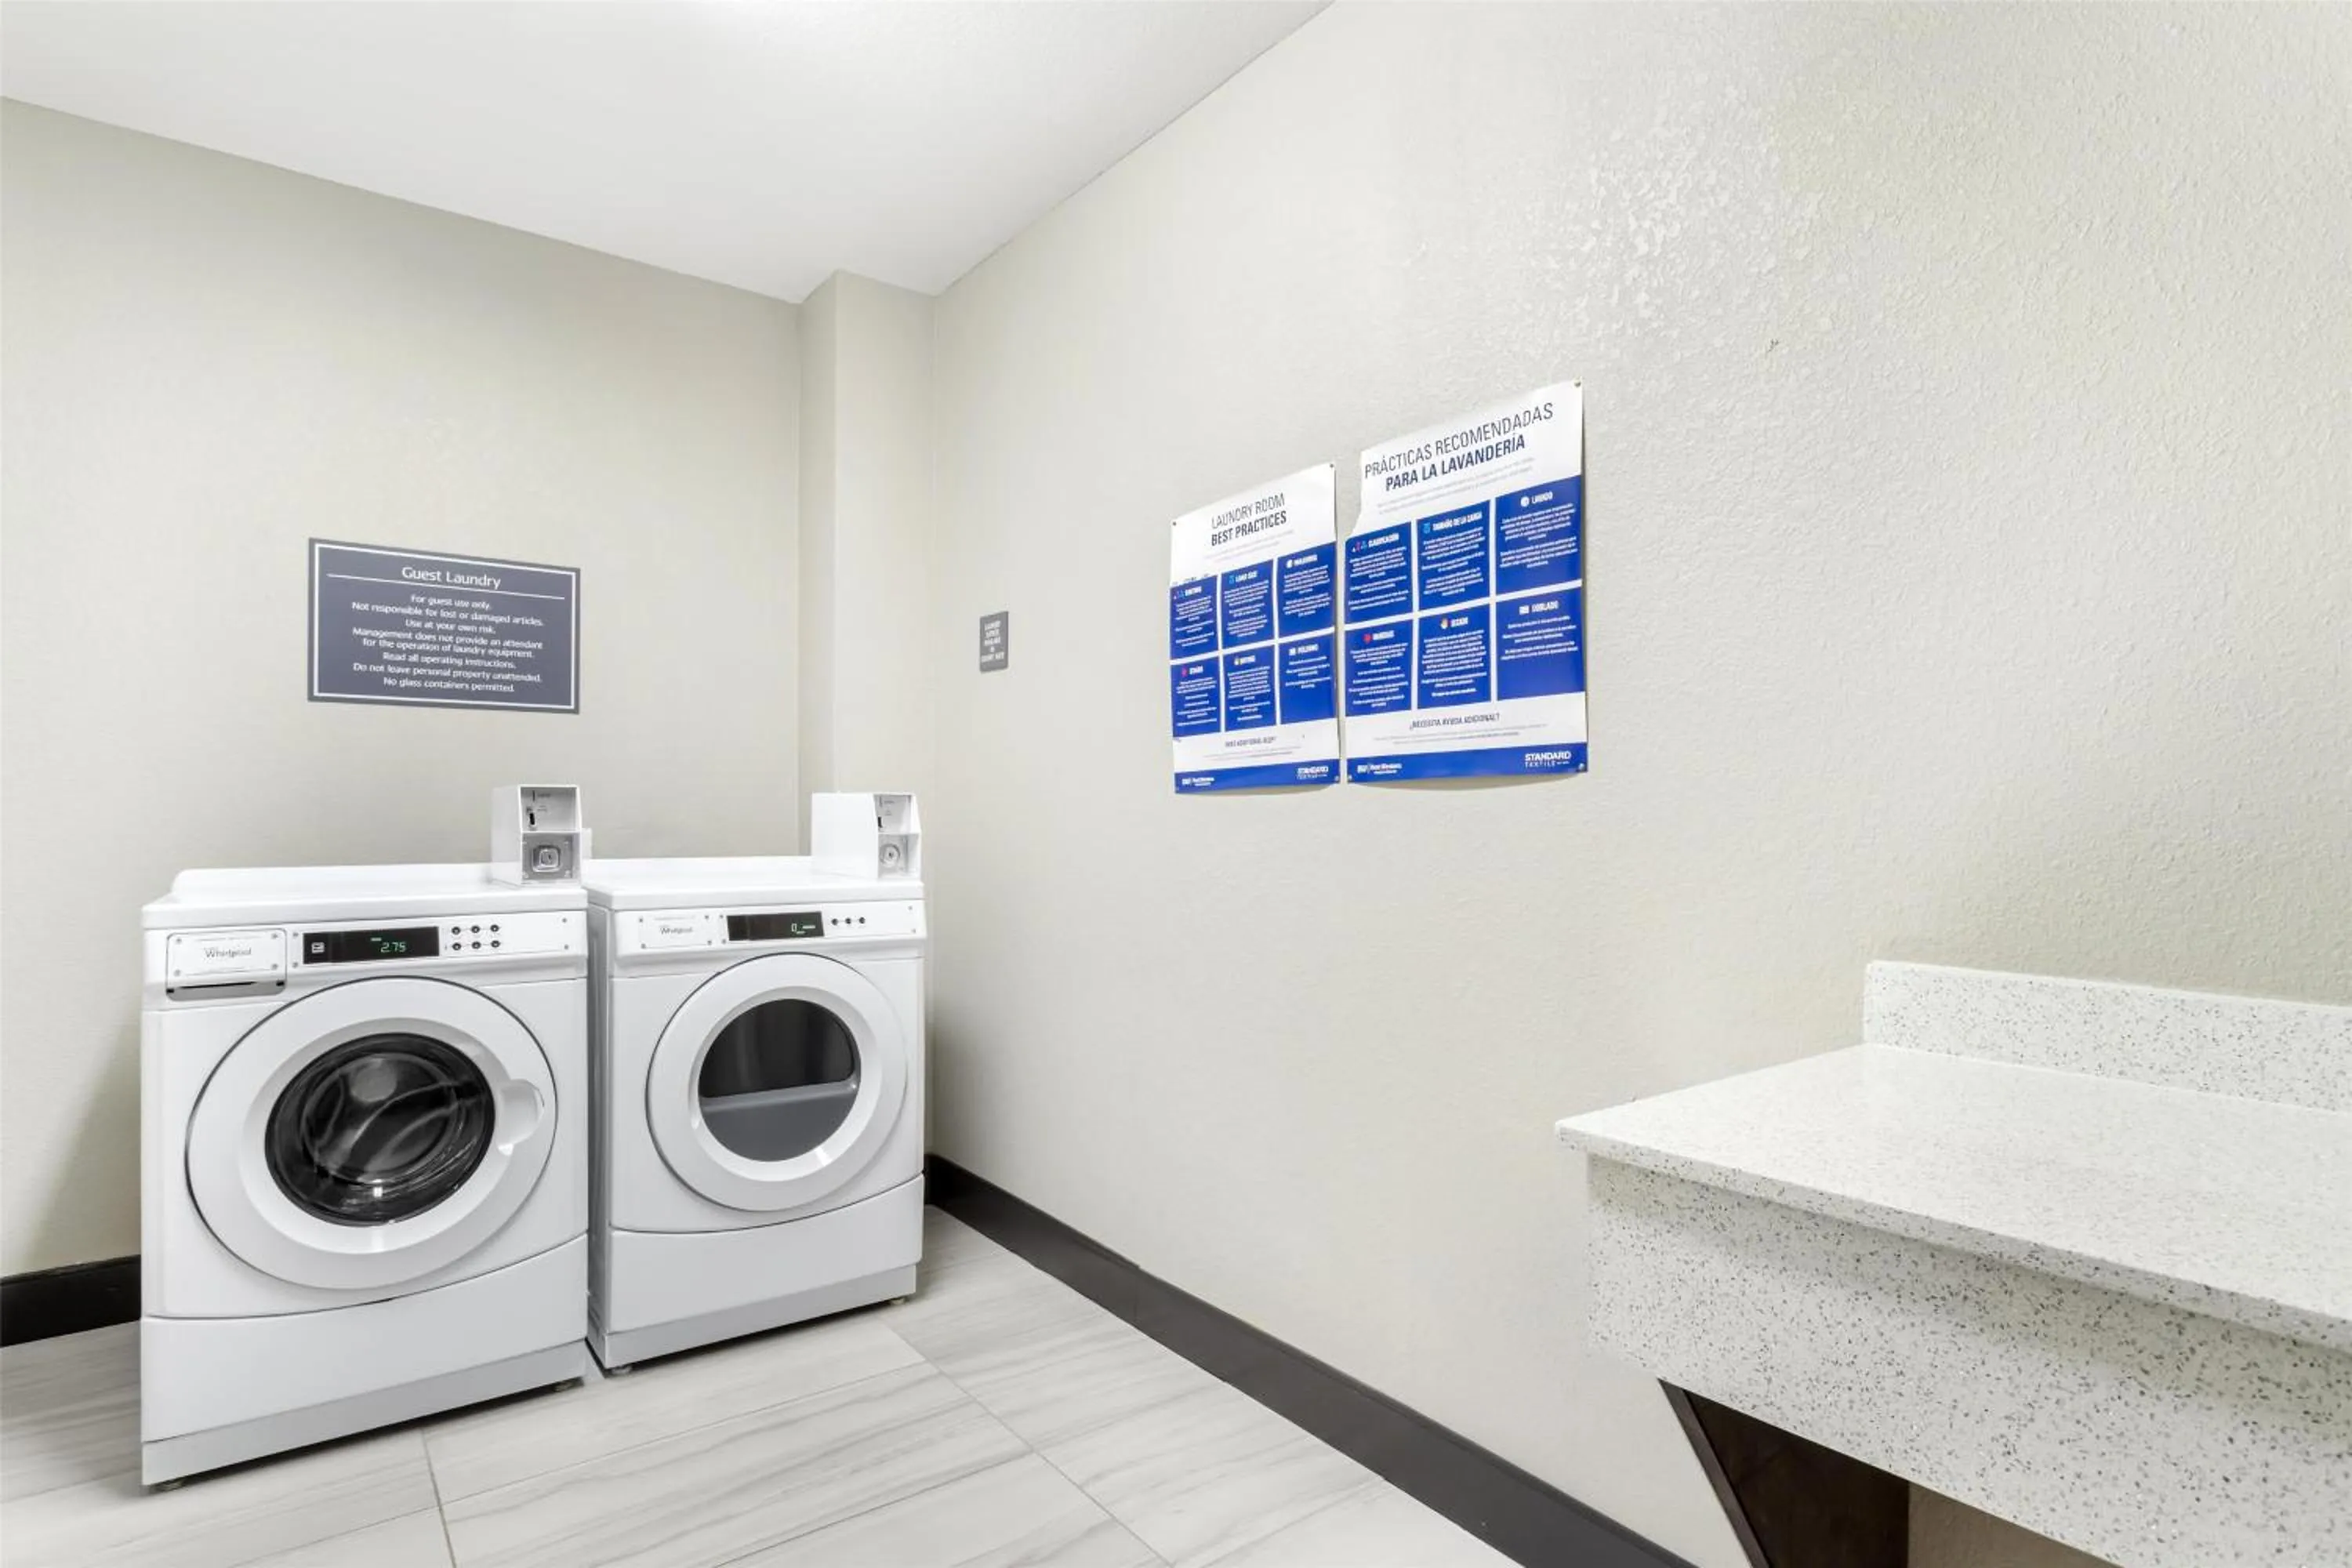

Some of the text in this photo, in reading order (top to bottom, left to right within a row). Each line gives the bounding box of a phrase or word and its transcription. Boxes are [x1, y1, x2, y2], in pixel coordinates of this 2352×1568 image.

[1365, 444, 1432, 479] PRÁCTICAS
[1436, 402, 1553, 456] RECOMENDADAS
[1386, 469, 1418, 492] PARA
[1422, 464, 1438, 481] LA
[1442, 432, 1526, 476] LAVANDERÍA
[1211, 492, 1285, 529] LAUNDRY ROOM
[1211, 528, 1233, 546] BEST
[1235, 510, 1287, 538] PRACTICES
[401, 567, 501, 590] Guest Laundry
[411, 594, 426, 603] For
[352, 601, 369, 611] Not
[371, 604, 423, 615] responsible
[426, 608, 437, 616] for
[440, 609, 456, 618] lost
[471, 612, 510, 624] damaged
[513, 616, 543, 626] articles.
[405, 619, 422, 627] Use
[353, 627, 412, 639] Management
[415, 631, 436, 641] does
[456, 635, 488, 644] provide
[503, 640, 543, 649] attendant
[453, 644, 485, 655] laundry
[383, 652, 406, 661] Read
[408, 654, 419, 662] all
[420, 656, 463, 666] operating
[353, 662, 367, 671] Do
[387, 664, 411, 673] leave
[413, 667, 451, 676] personal
[453, 670, 491, 681] property
[383, 677, 397, 686] No
[400, 678, 422, 688] glass
[424, 680, 469, 689] containers
[1525, 750, 1572, 760] STANDARD
[1525, 760, 1555, 768] TEXTILE
[204, 948, 252, 958] Whirlpool
